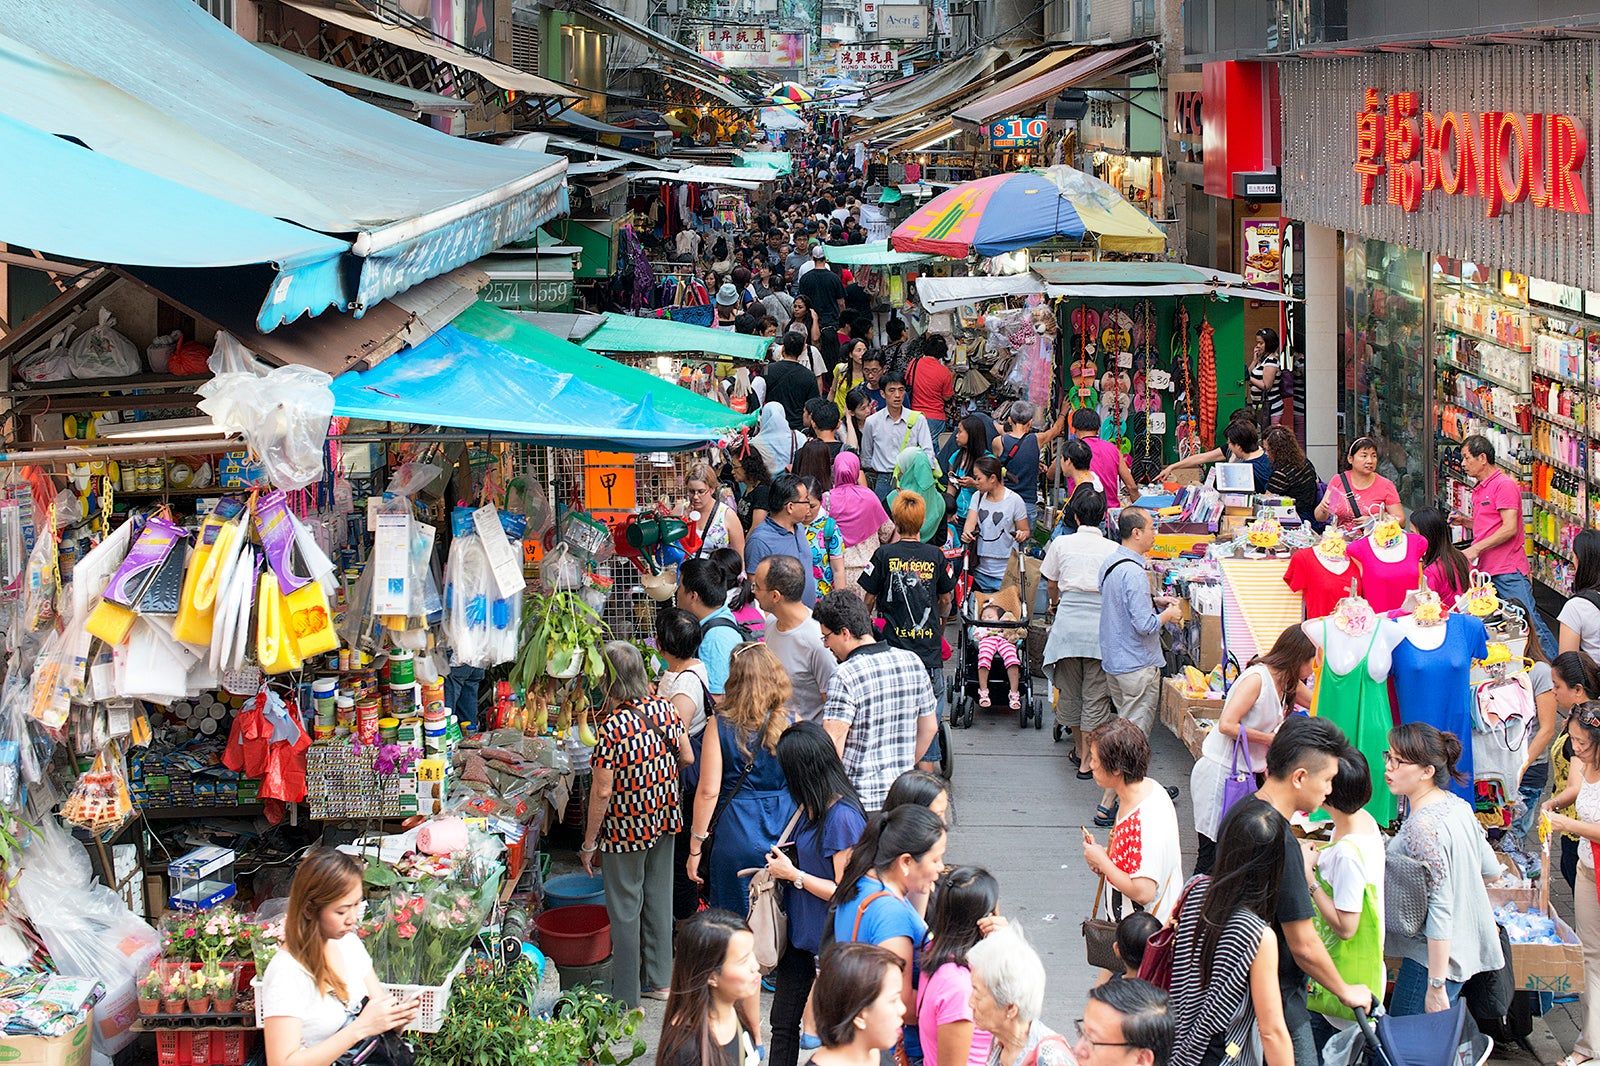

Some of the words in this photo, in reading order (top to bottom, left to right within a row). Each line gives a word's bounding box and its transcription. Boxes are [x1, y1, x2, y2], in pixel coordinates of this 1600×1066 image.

[841, 51, 894, 64] 鴻興玩具
[1173, 91, 1203, 136] KFC
[993, 119, 1048, 138] $10
[1423, 111, 1591, 218] BONJOUR
[484, 282, 520, 303] 2574
[529, 282, 567, 303] 0559
